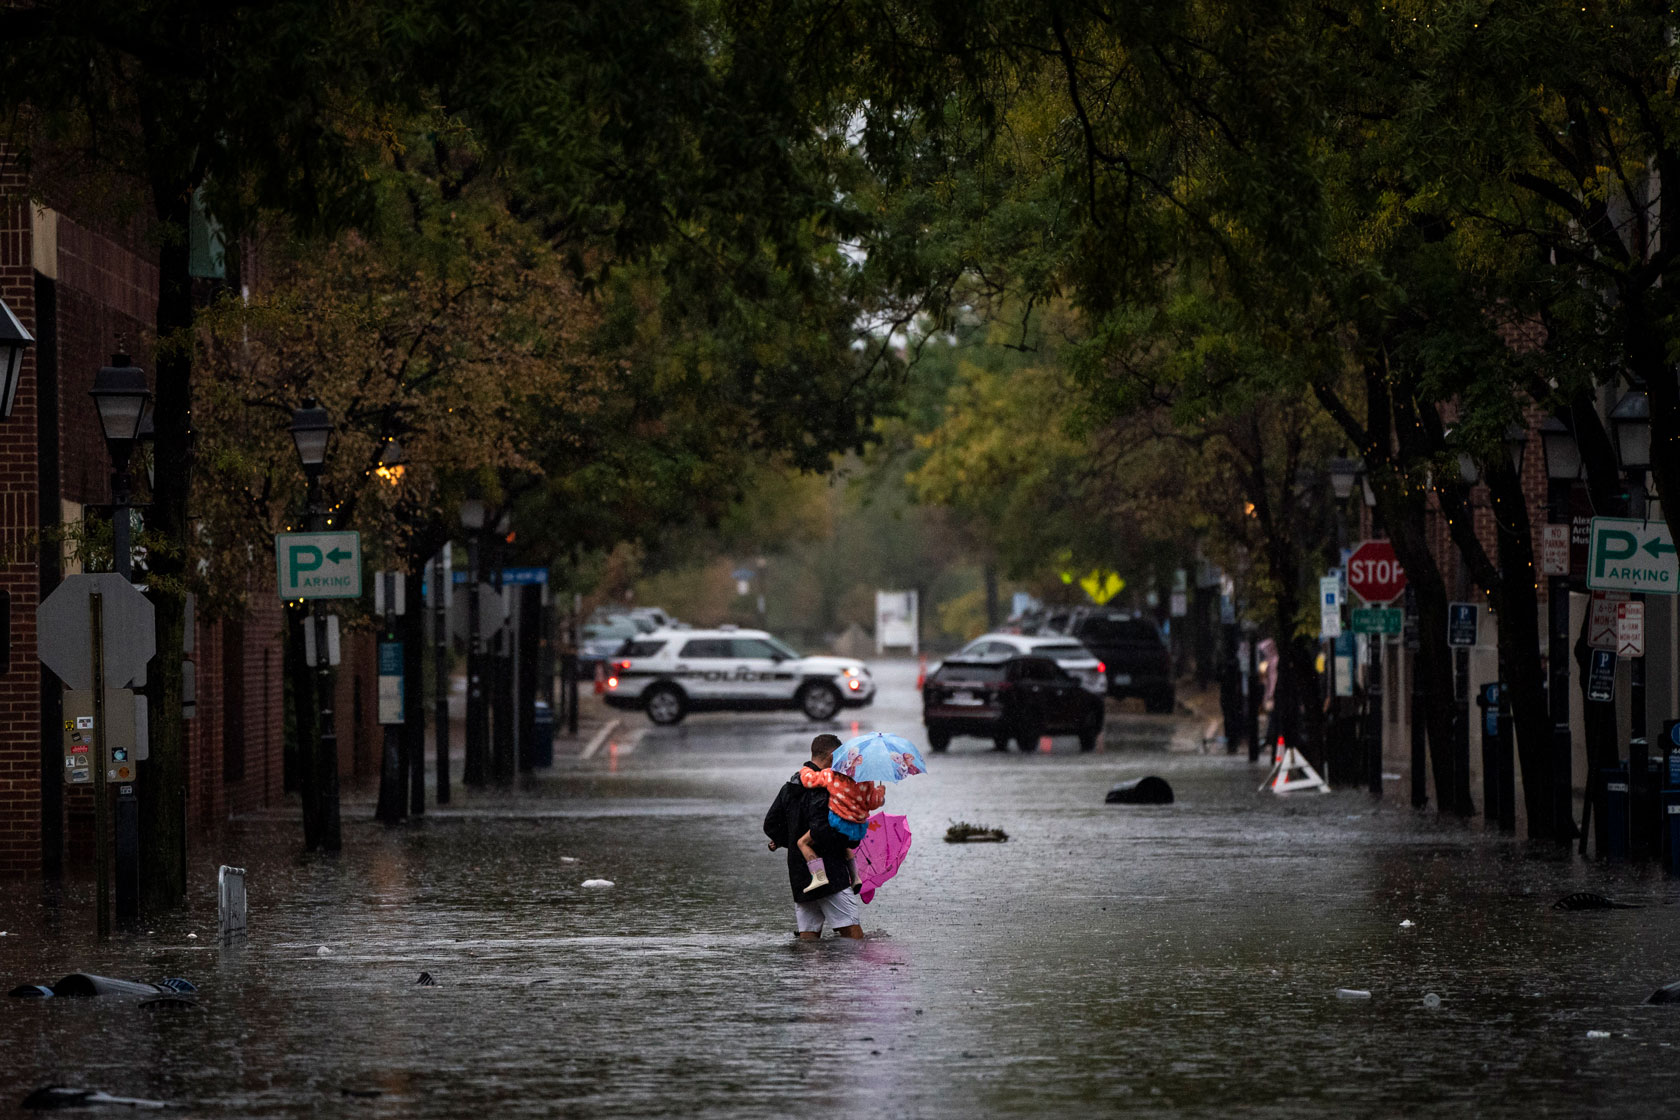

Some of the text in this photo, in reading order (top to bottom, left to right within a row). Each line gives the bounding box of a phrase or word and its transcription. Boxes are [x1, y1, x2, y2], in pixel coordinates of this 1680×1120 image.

[1551, 527, 1562, 538] NO
[1545, 539, 1567, 549] PARKING
[1600, 653, 1609, 667] P
[694, 671, 776, 682] POLICE
